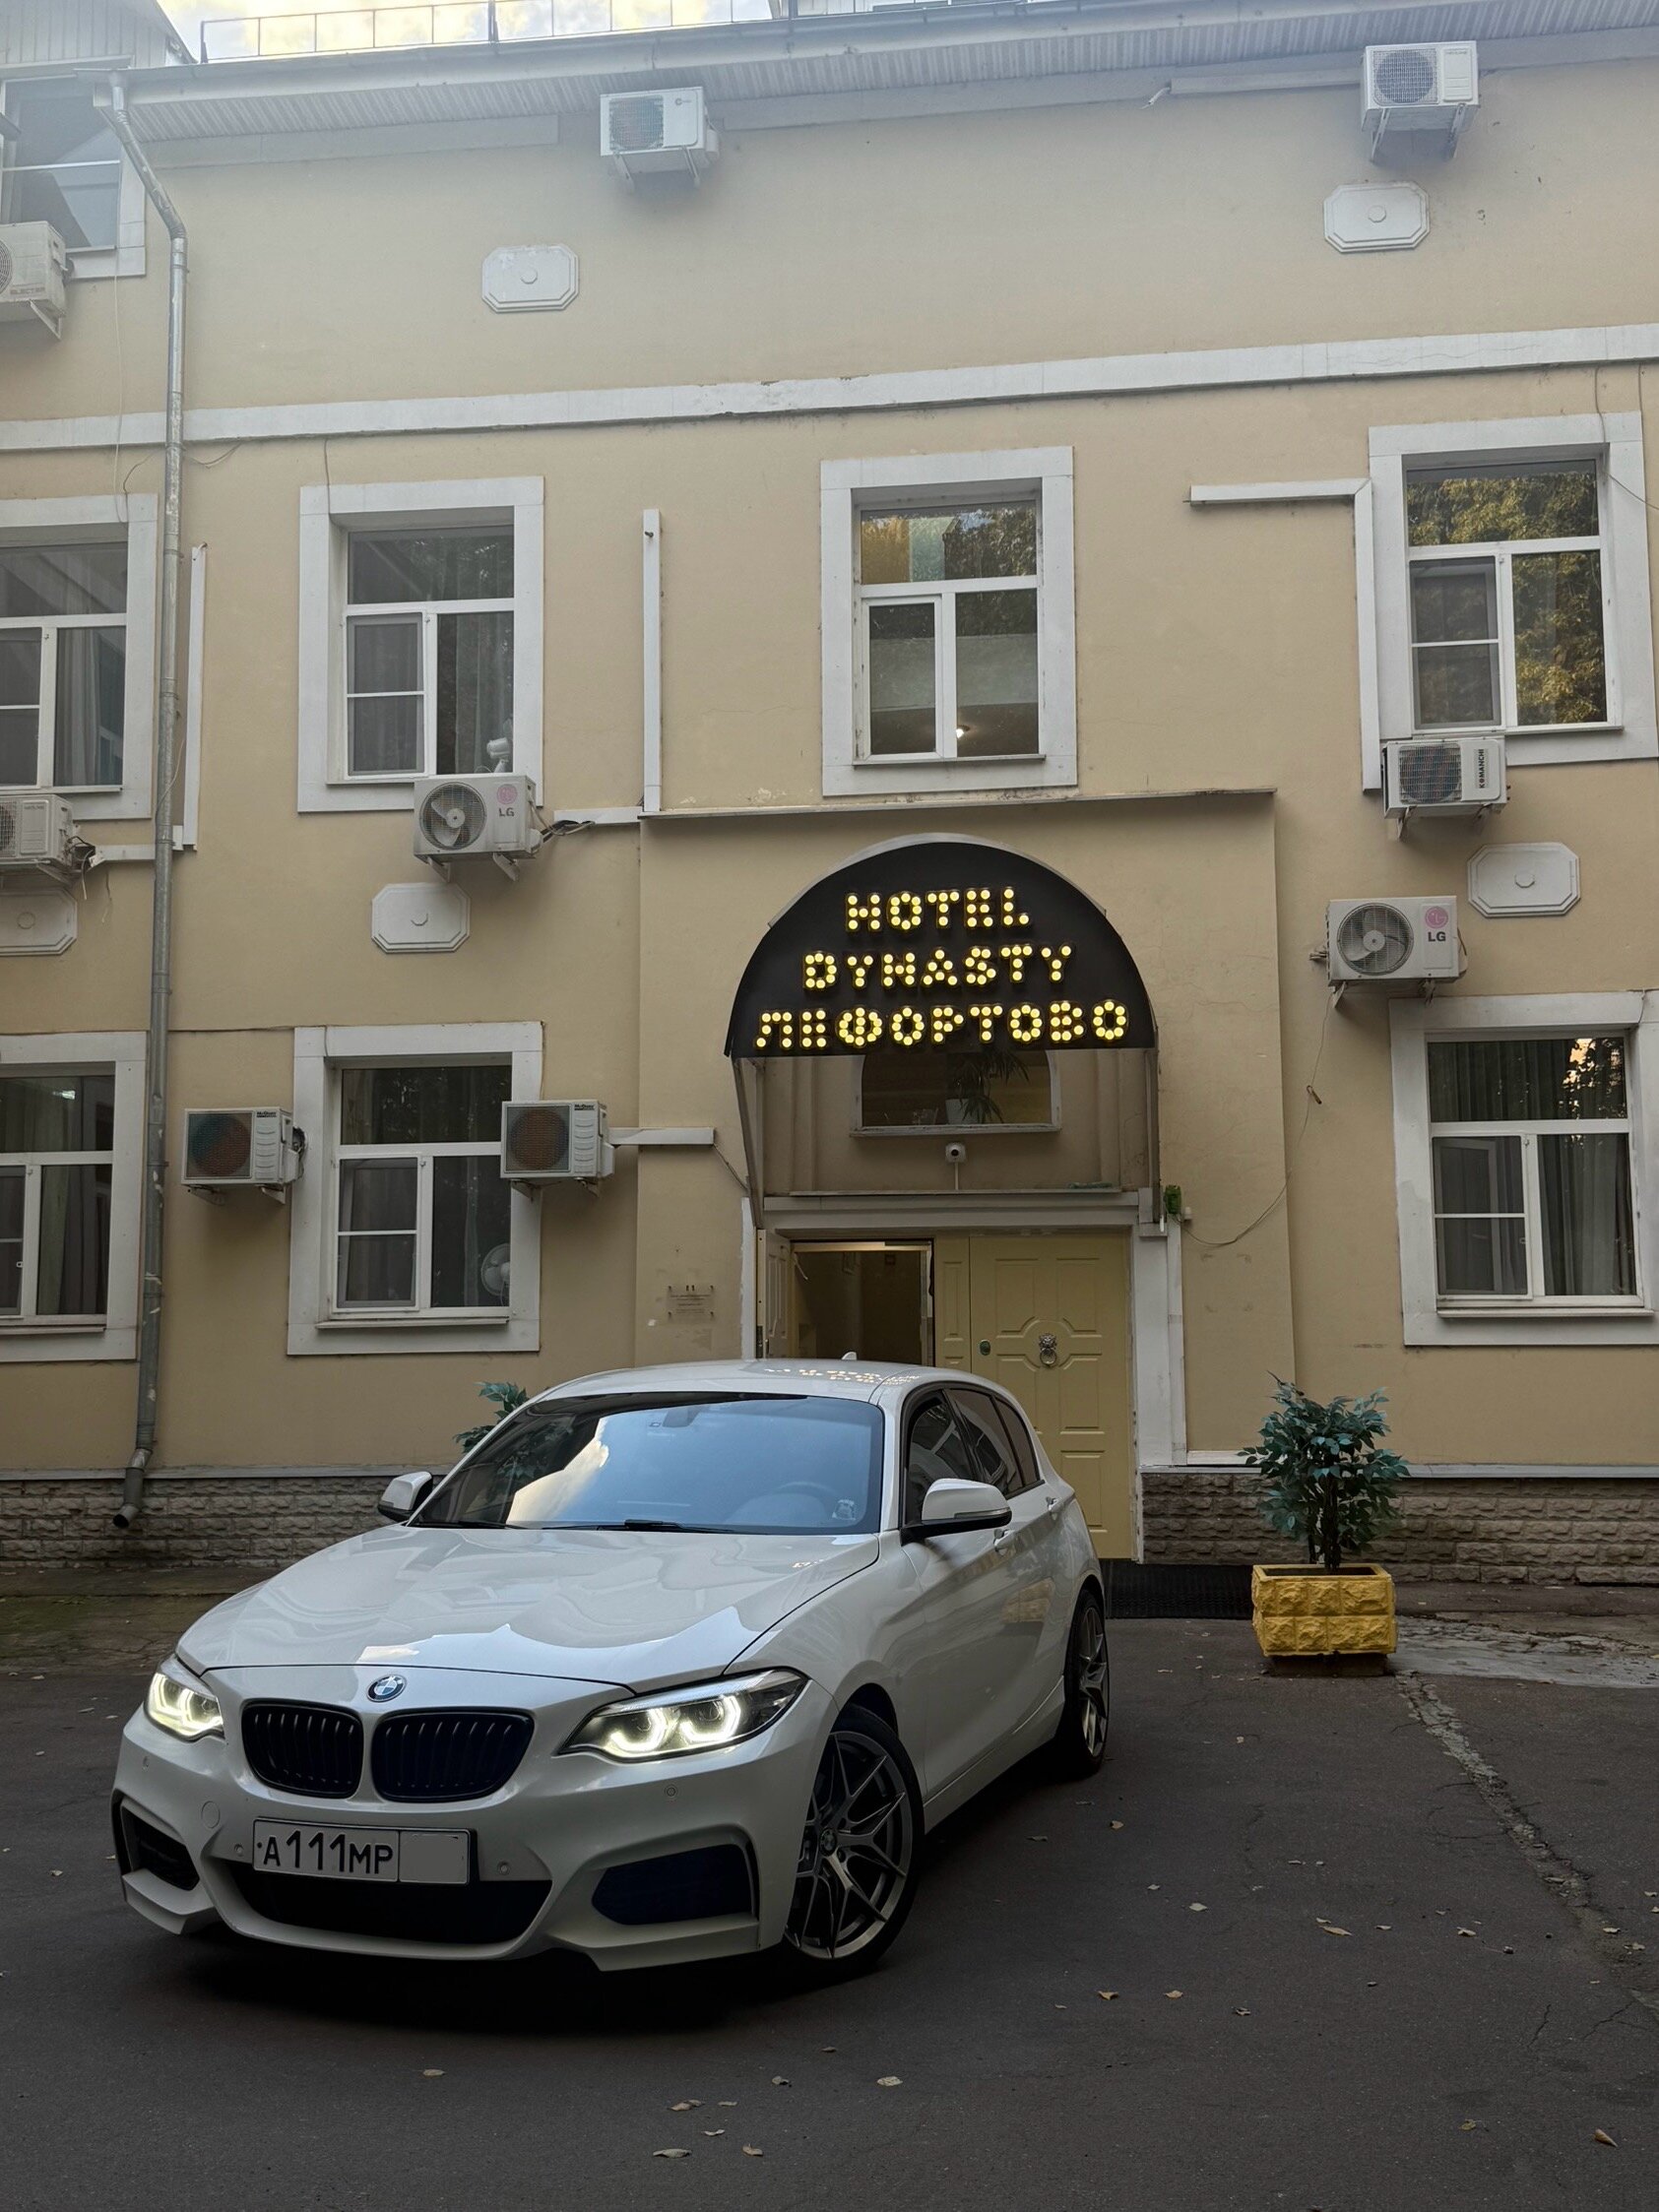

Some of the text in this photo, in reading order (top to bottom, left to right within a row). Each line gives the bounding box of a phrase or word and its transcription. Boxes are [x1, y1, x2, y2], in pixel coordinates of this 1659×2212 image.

[498, 807, 515, 817] LG
[846, 887, 1031, 932] HOTEL
[1428, 931, 1446, 942] LG
[802, 944, 1072, 990] DYNASTY
[753, 998, 1130, 1050] ЛЕФОРТОВО
